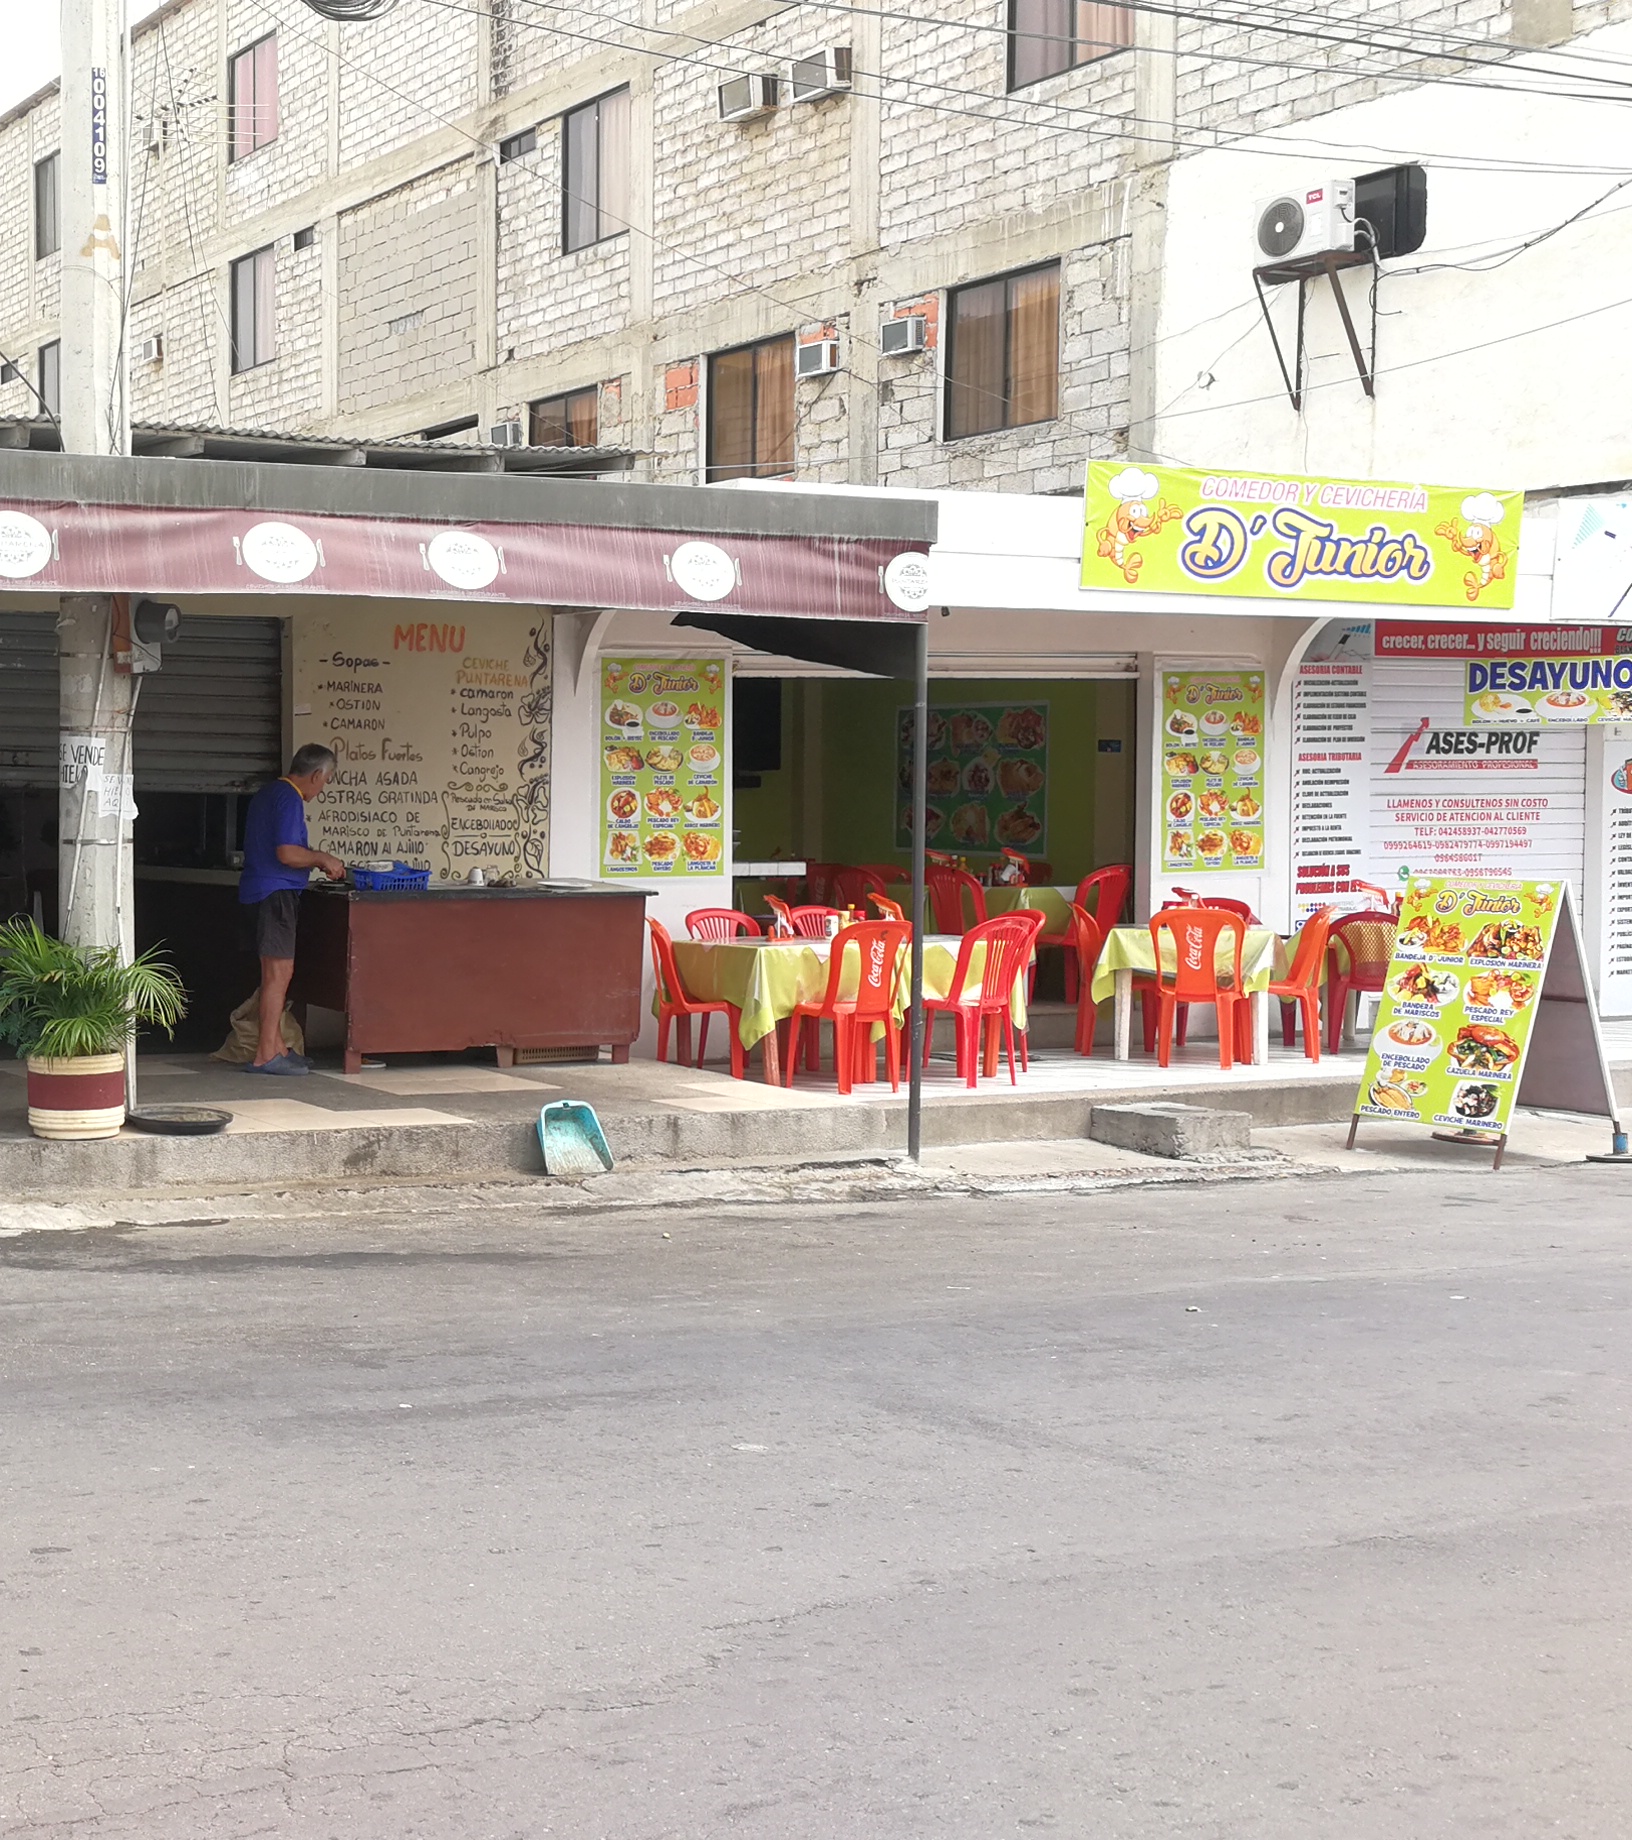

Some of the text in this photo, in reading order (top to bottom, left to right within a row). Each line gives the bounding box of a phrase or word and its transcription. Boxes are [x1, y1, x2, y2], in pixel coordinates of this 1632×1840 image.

[1202, 478, 1299, 501] COMEDOR
[1304, 485, 1317, 501] Y
[1267, 508, 1430, 587] Junior
[394, 623, 466, 652] MENU
[1477, 635, 1486, 651] y
[1486, 629, 1526, 652] seguir
[1530, 627, 1602, 654] creciendo!!!
[462, 657, 509, 670] CEVICHE
[456, 669, 529, 687] PUNTARENA
[652, 671, 699, 695] Junior
[459, 688, 514, 699] camaron
[336, 698, 381, 710] OSTION
[461, 702, 512, 723] Langosta
[330, 717, 385, 730] CAMARON
[459, 722, 492, 743] Pulpo
[330, 736, 376, 761] Platos
[1426, 731, 1540, 754] ASES-PROF
[71, 744, 105, 766] VENDE
[461, 743, 494, 758] Ostion
[1298, 753, 1327, 761] ASESORIA
[459, 761, 504, 782] Cangrejo
[375, 771, 418, 786] ASADA
[104, 787, 130, 796] HIEO
[317, 790, 438, 805] OSTRAS GRATINDA
[1387, 799, 1548, 808] LLAMENOS Y CONSULTENOS SIN COSTO
[318, 809, 420, 823] AFRODISIACO DE
[1395, 812, 1540, 822] SERVICIO DE ATENCION AL CLIENTE
[322, 825, 370, 837] MARISCO
[377, 828, 387, 837] DE
[1415, 827, 1437, 836] TELF:
[318, 839, 378, 856] CAMARON
[452, 840, 515, 857] DESAYUNO
[1463, 890, 1521, 915] Junior
[1395, 952, 1426, 961] BANDEJA
[1507, 960, 1541, 969] MARINERA
[1402, 1002, 1434, 1010] BANDERA
[1465, 1006, 1498, 1015] PESCADO
[1403, 1009, 1440, 1017] MARISCOS
[1471, 1015, 1504, 1023] ESPECIAL
[1381, 1053, 1430, 1064] ENCEBOLLADO
[1394, 1062, 1425, 1070] PESCADO
[1446, 1068, 1512, 1080] CAZUELA MARINERA
[1361, 1106, 1420, 1119] PESCADO ENTERO
[1434, 1115, 1502, 1129] CEVICHE MARINERO
